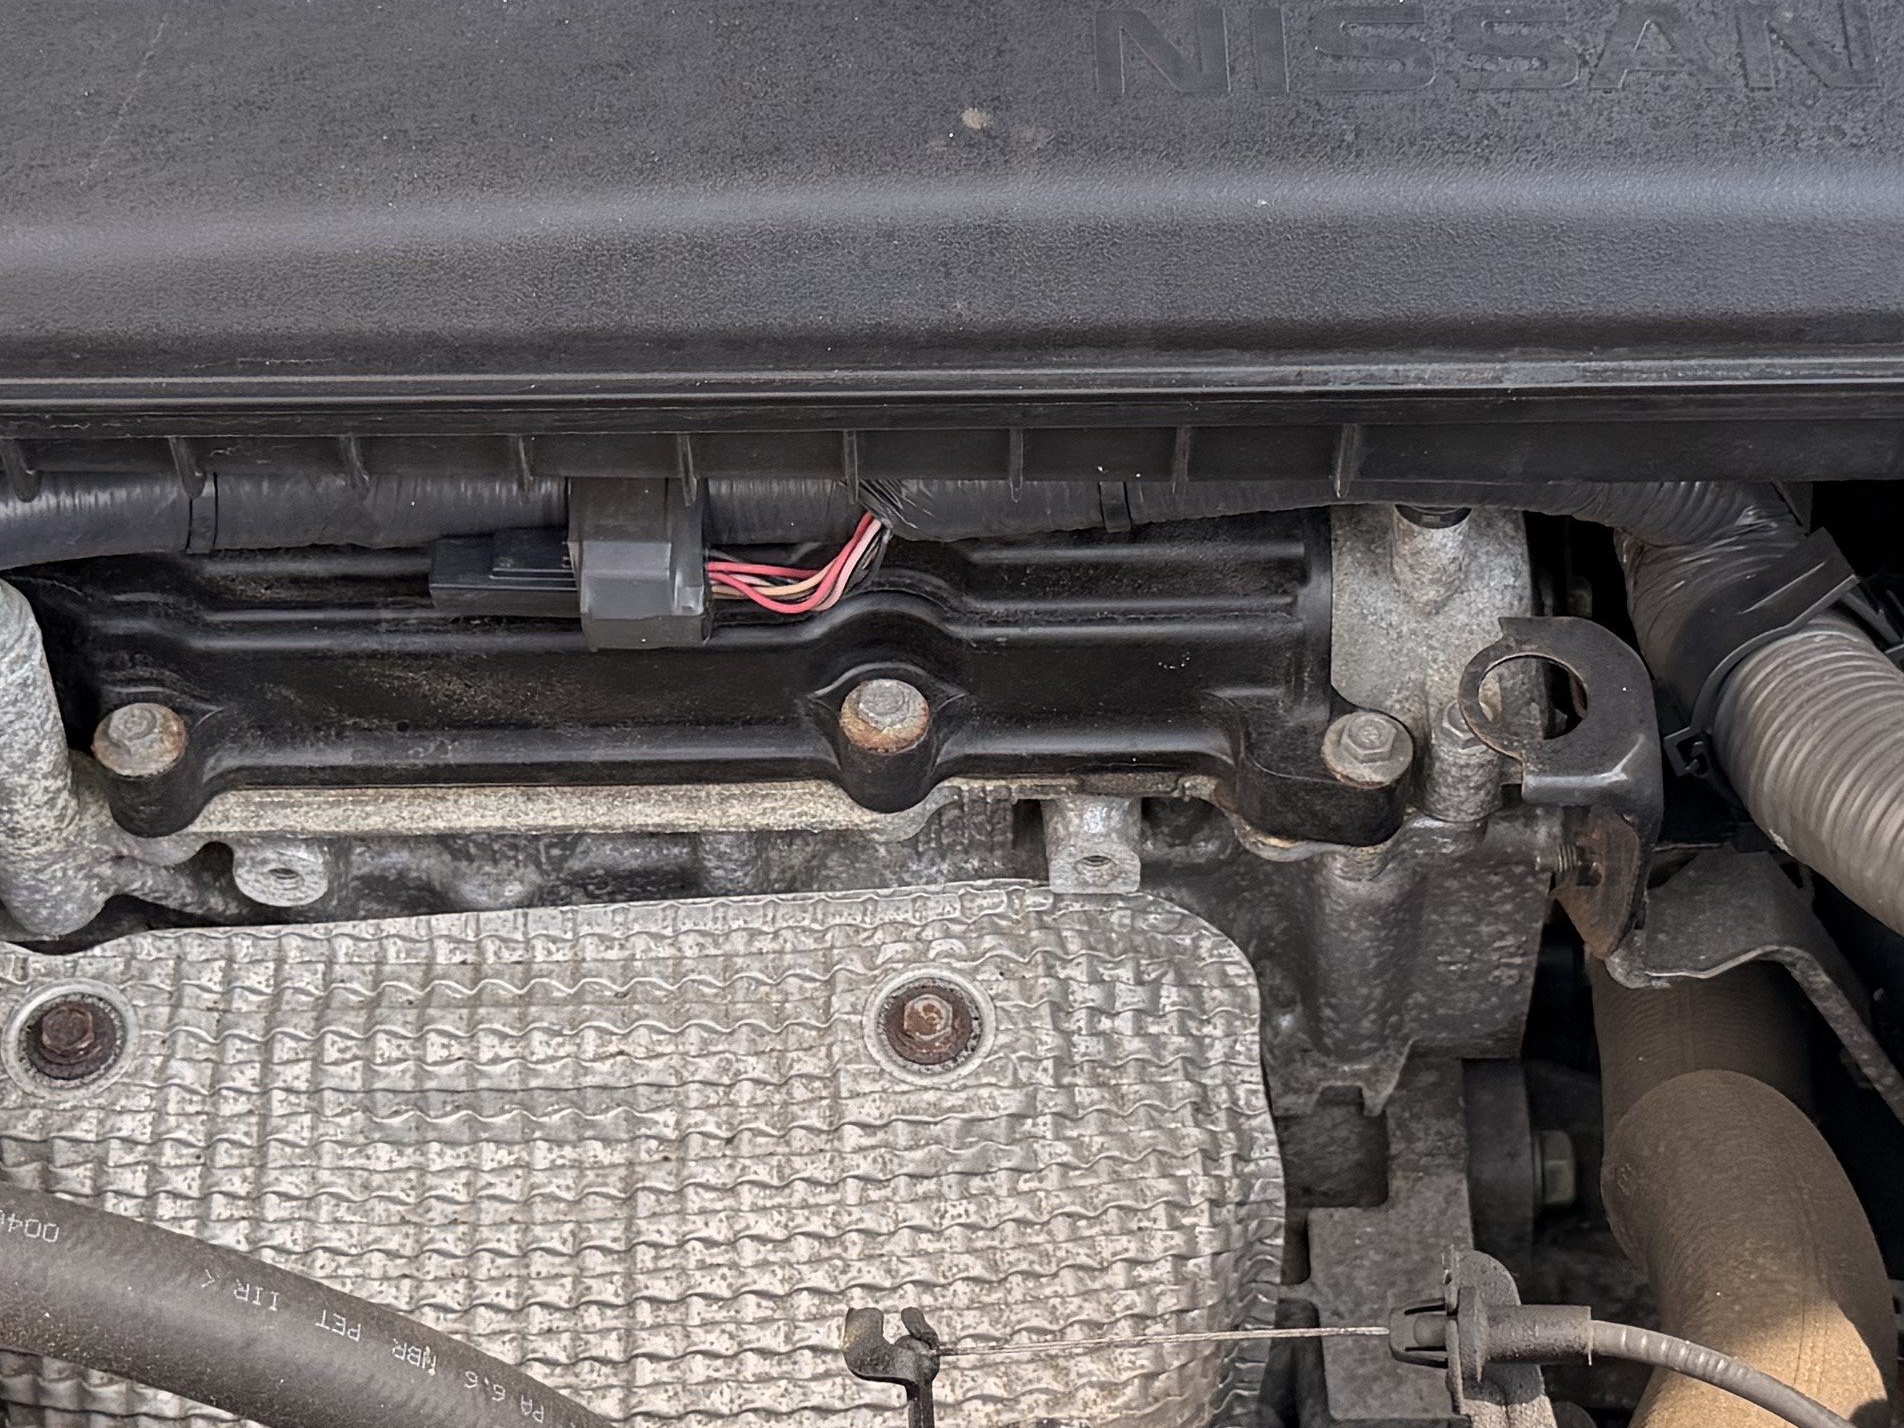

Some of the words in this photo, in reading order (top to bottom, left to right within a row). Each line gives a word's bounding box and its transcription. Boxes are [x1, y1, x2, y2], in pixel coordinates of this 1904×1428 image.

[1093, 1, 1881, 93] NISSAN
[233, 1278, 282, 1312] IIR
[315, 1309, 362, 1342] PET
[392, 1338, 438, 1374] NBR
[520, 1394, 545, 1423] PA
